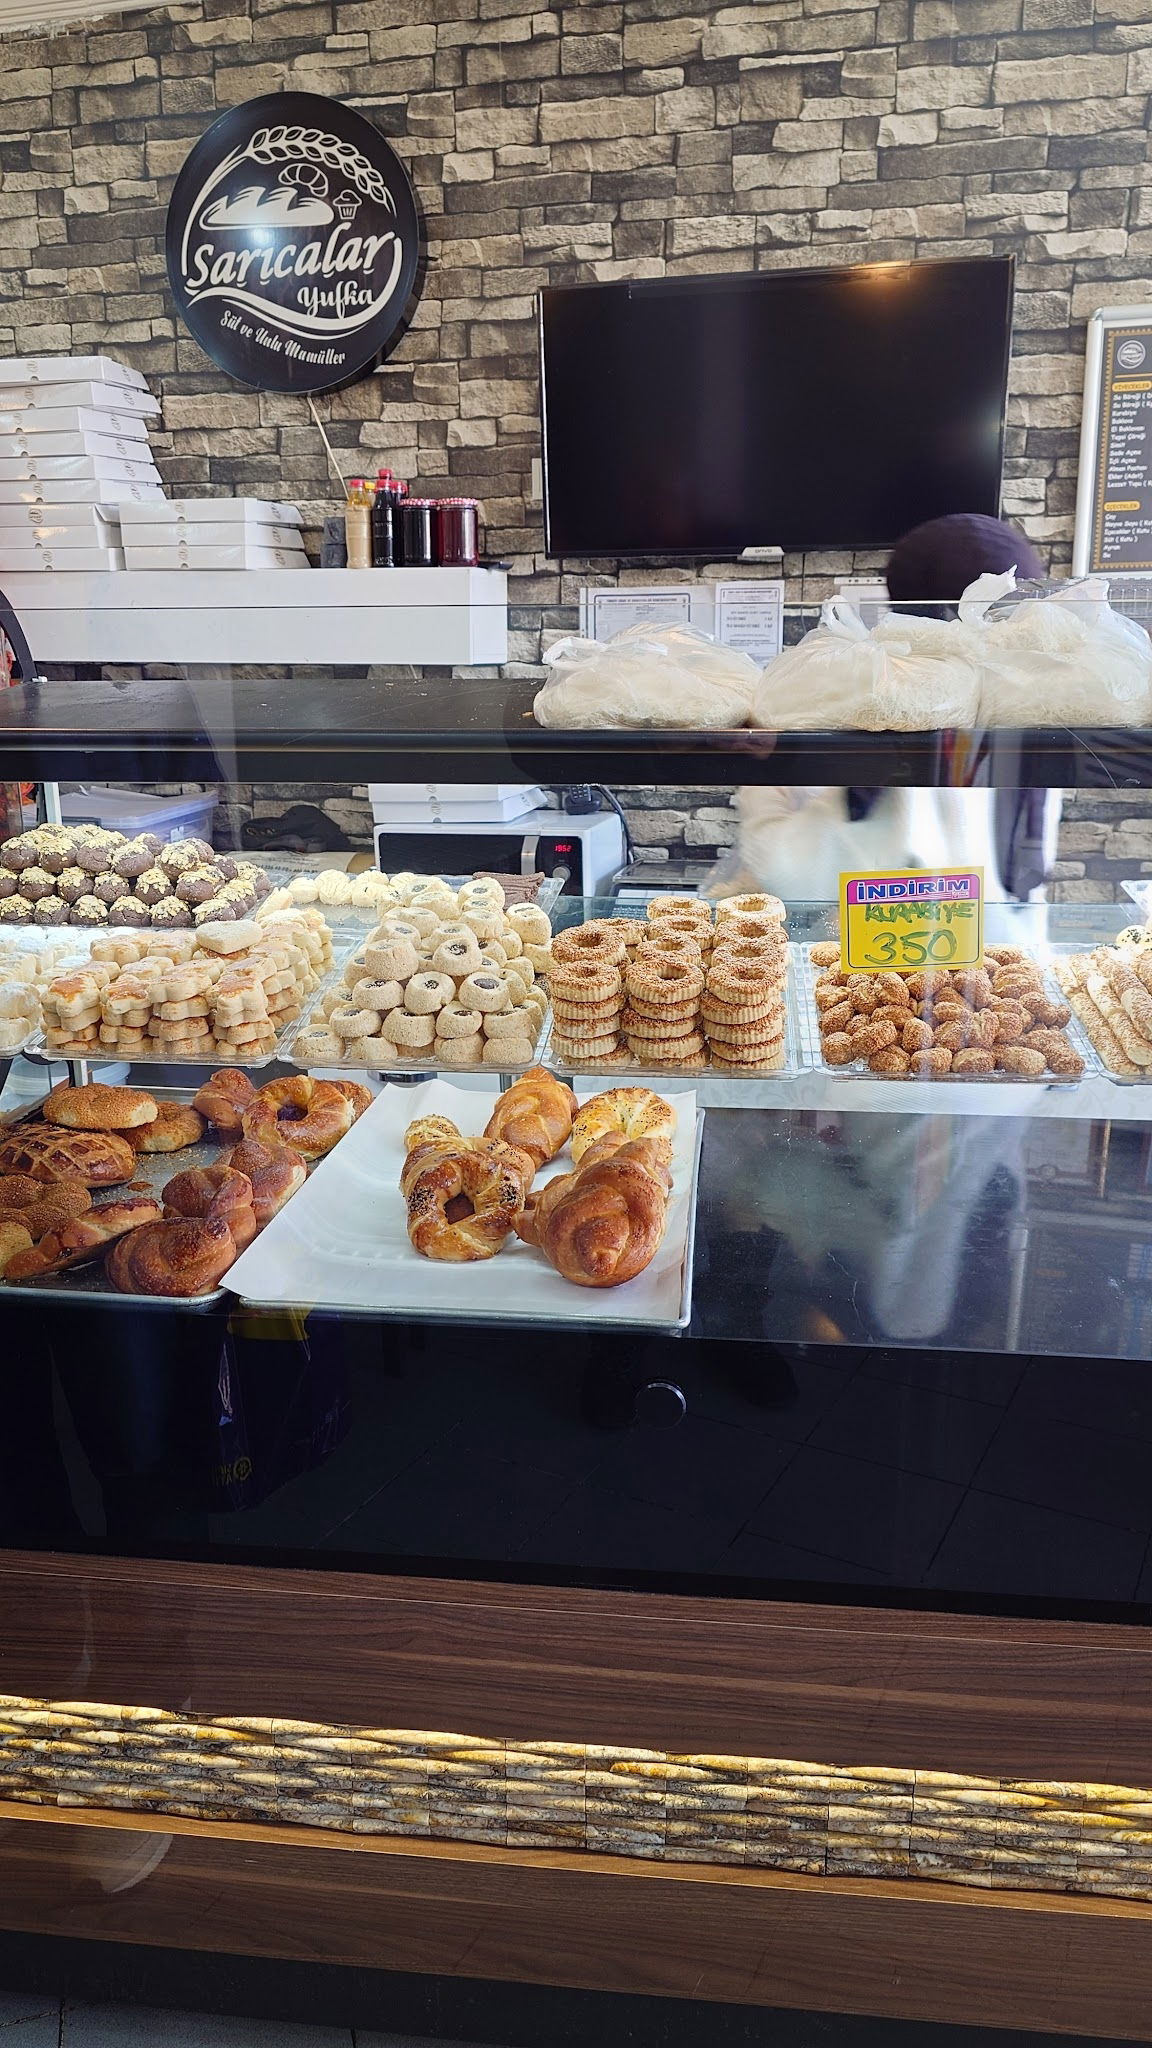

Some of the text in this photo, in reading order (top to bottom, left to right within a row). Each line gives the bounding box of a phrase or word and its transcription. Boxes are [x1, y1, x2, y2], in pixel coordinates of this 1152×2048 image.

[297, 281, 375, 319] Yufka
[240, 323, 253, 338] ve
[858, 880, 969, 900] İNDİRİM
[864, 929, 957, 965] 350
